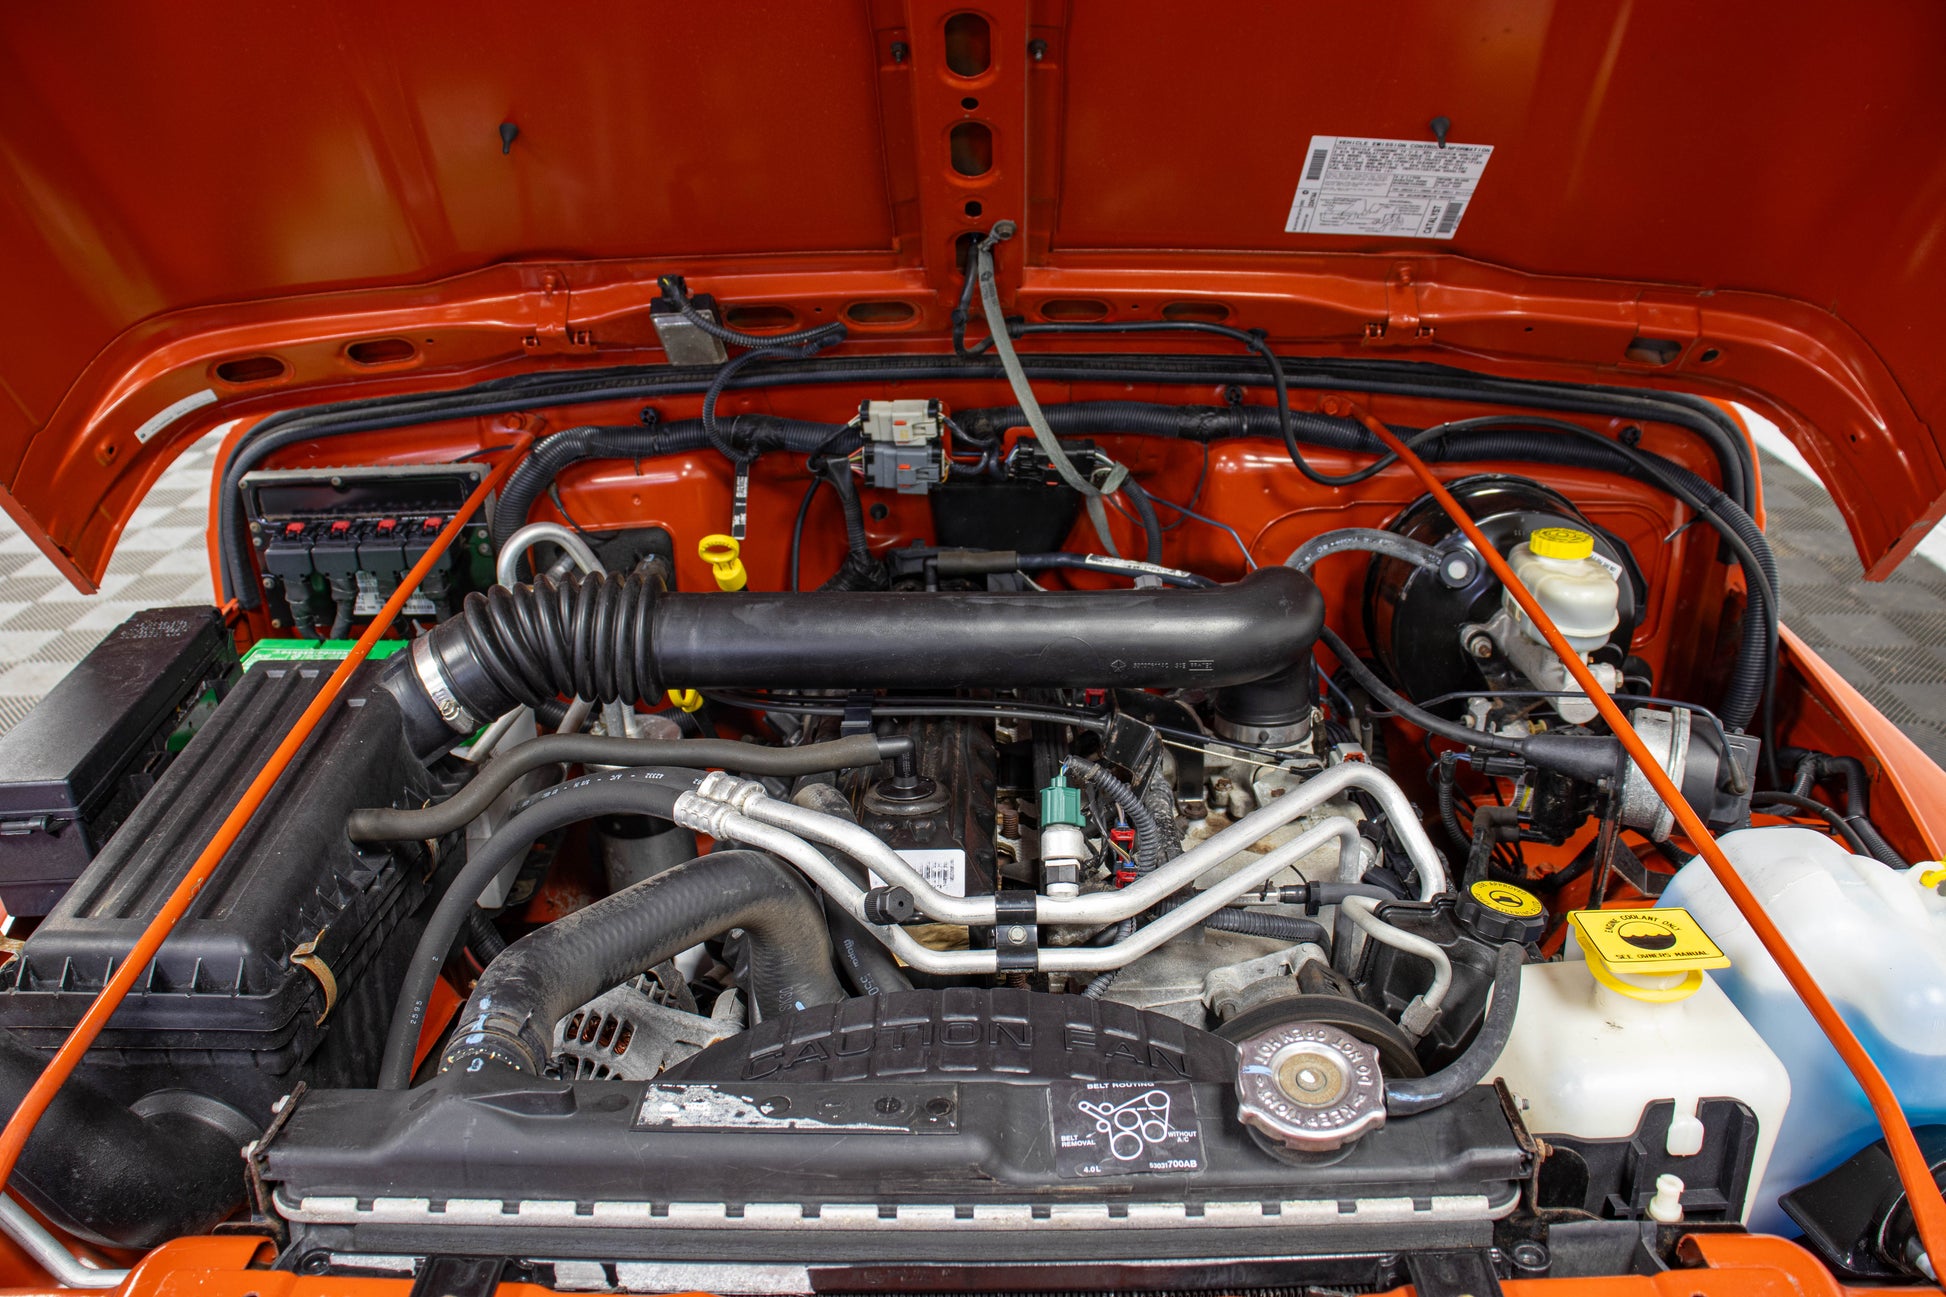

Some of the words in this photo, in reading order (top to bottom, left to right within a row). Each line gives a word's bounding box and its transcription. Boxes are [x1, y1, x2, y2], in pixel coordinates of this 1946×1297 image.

[1423, 205, 1442, 234] CATALYST
[1620, 914, 1658, 922] COOLANT
[1662, 920, 1683, 931] ONLY
[742, 1022, 1032, 1081] CAUTION
[1063, 1028, 1194, 1079] FAN
[1168, 1130, 1197, 1138] WITHOUT
[1061, 1139, 1096, 1148] REMOVAL
